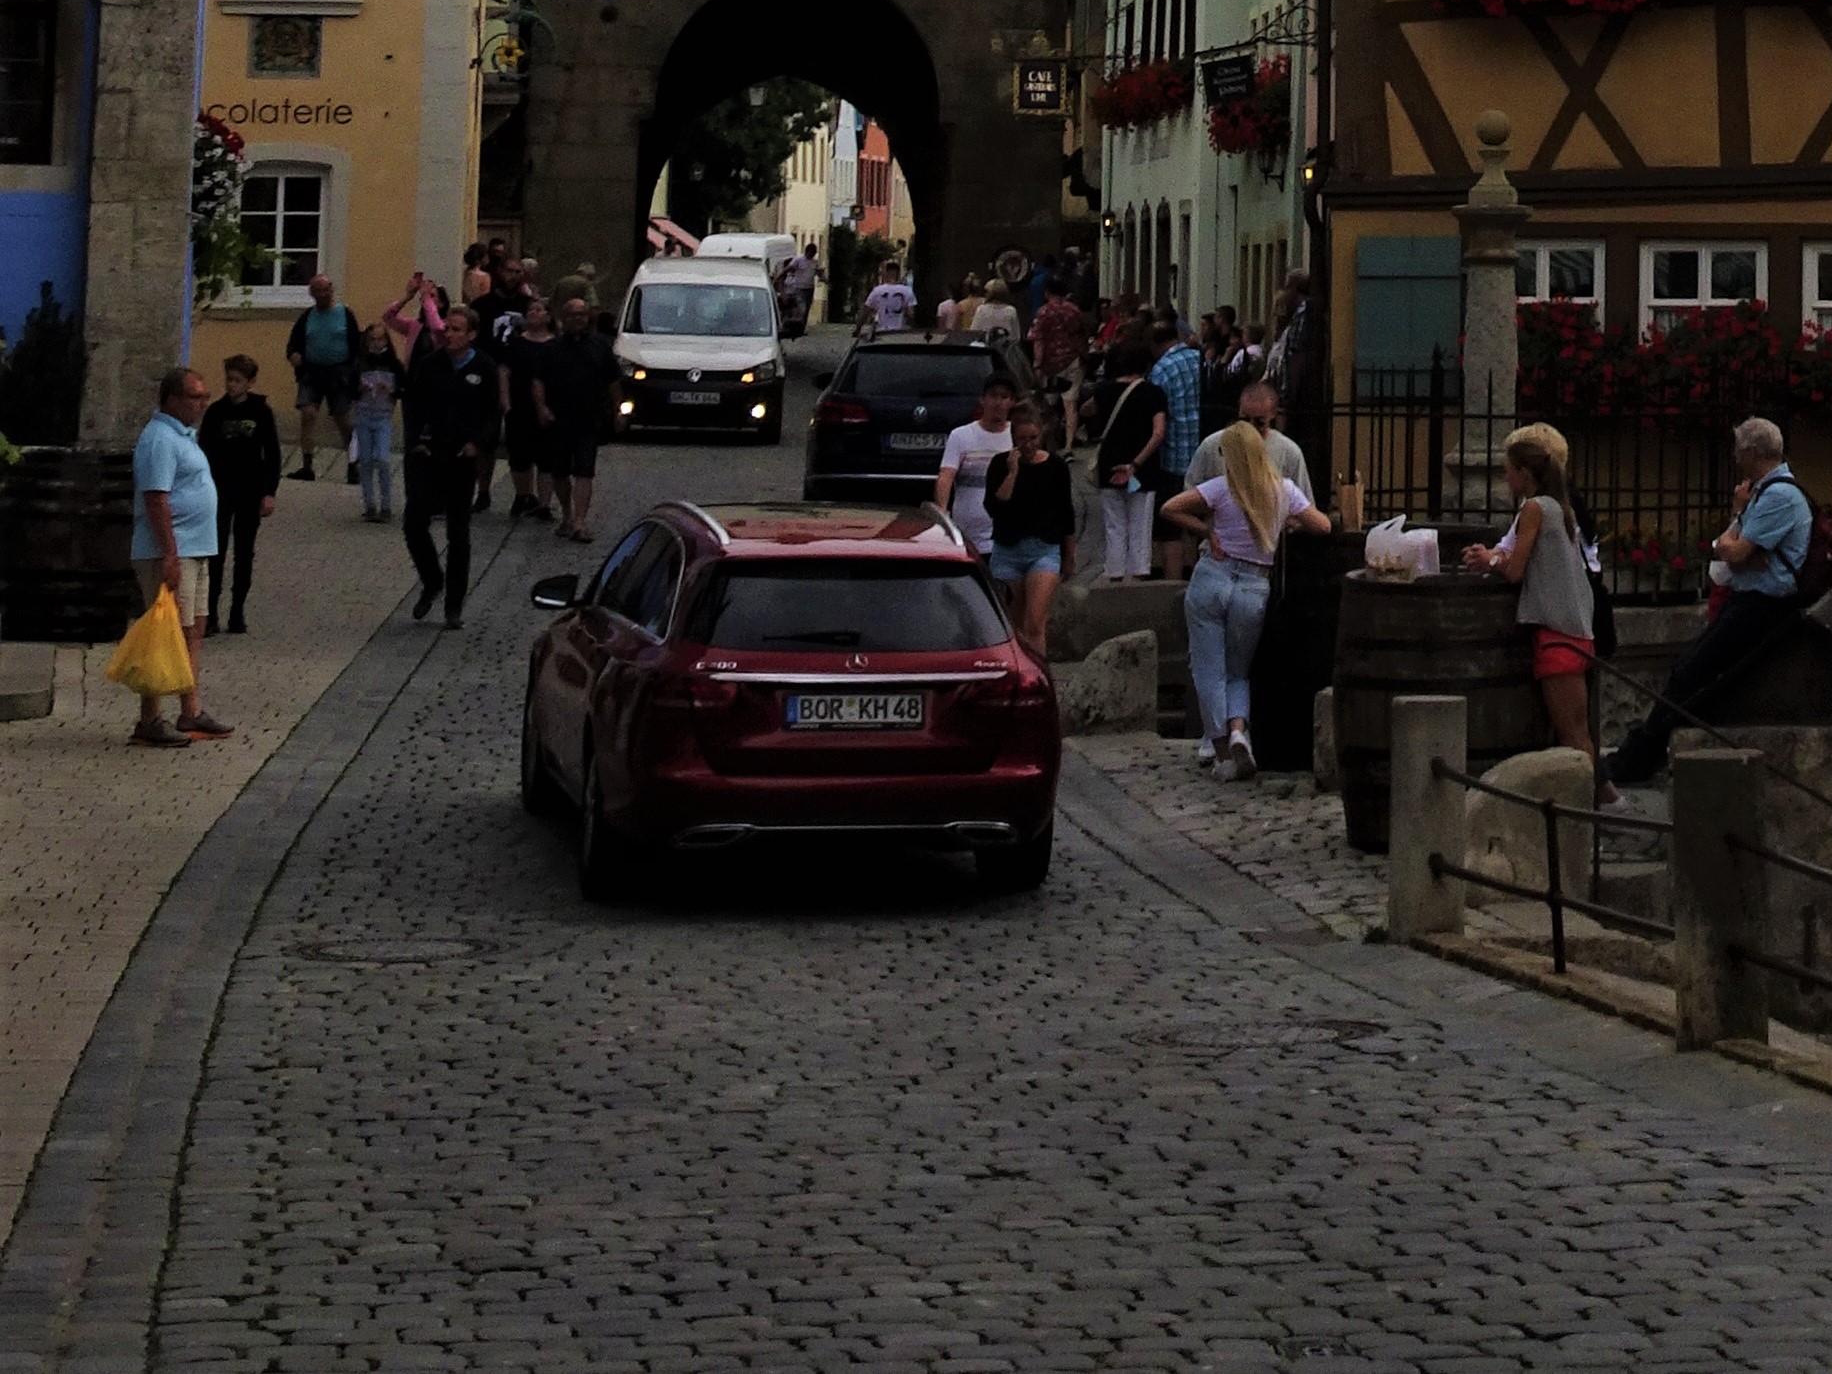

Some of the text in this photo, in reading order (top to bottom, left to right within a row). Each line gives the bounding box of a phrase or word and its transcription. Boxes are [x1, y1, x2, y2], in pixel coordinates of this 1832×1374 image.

[800, 698, 920, 720] BOR KH 48
